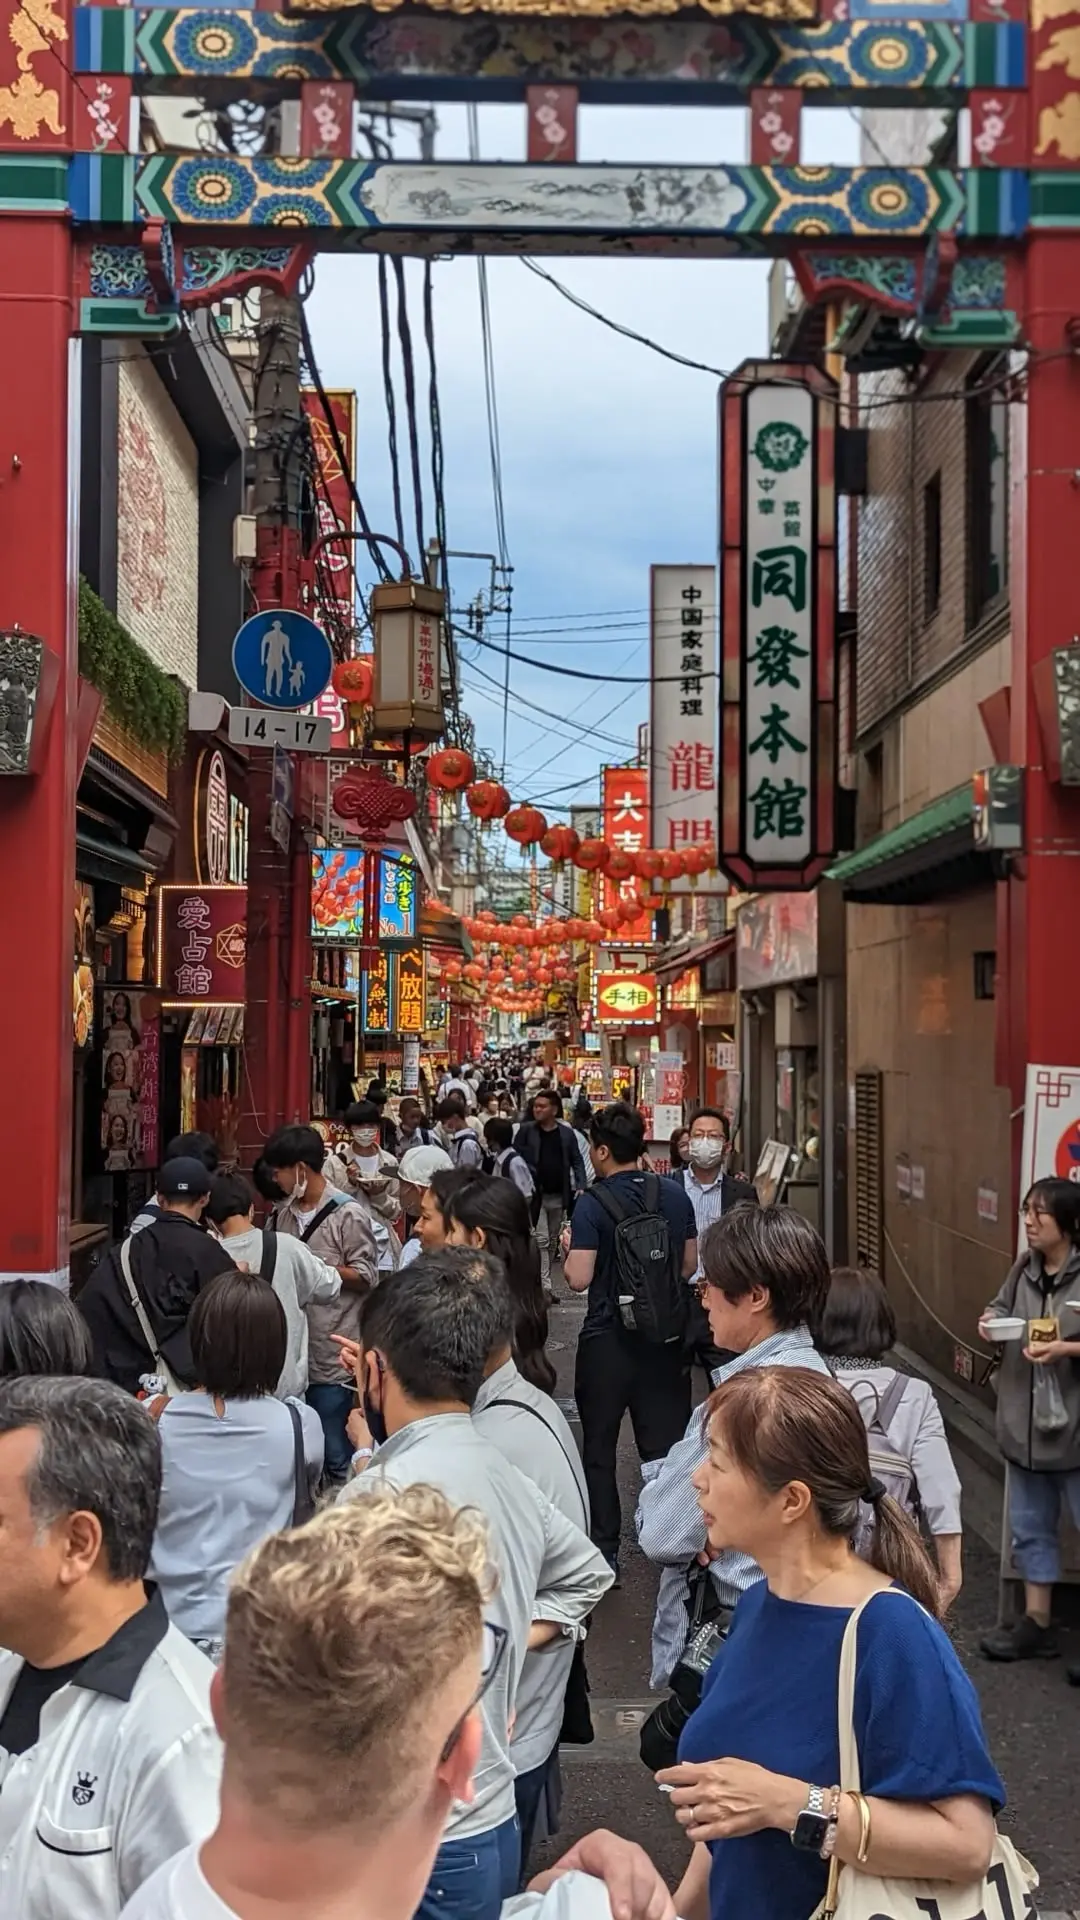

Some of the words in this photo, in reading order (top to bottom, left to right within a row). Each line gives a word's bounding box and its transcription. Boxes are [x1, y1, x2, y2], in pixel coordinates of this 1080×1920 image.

[680, 585, 704, 716] 中国家庭料理
[749, 545, 809, 840] 同發本館
[612, 791, 644, 900] 大吉い
[175, 897, 212, 994] 愛占館
[605, 988, 648, 1006] 手相
